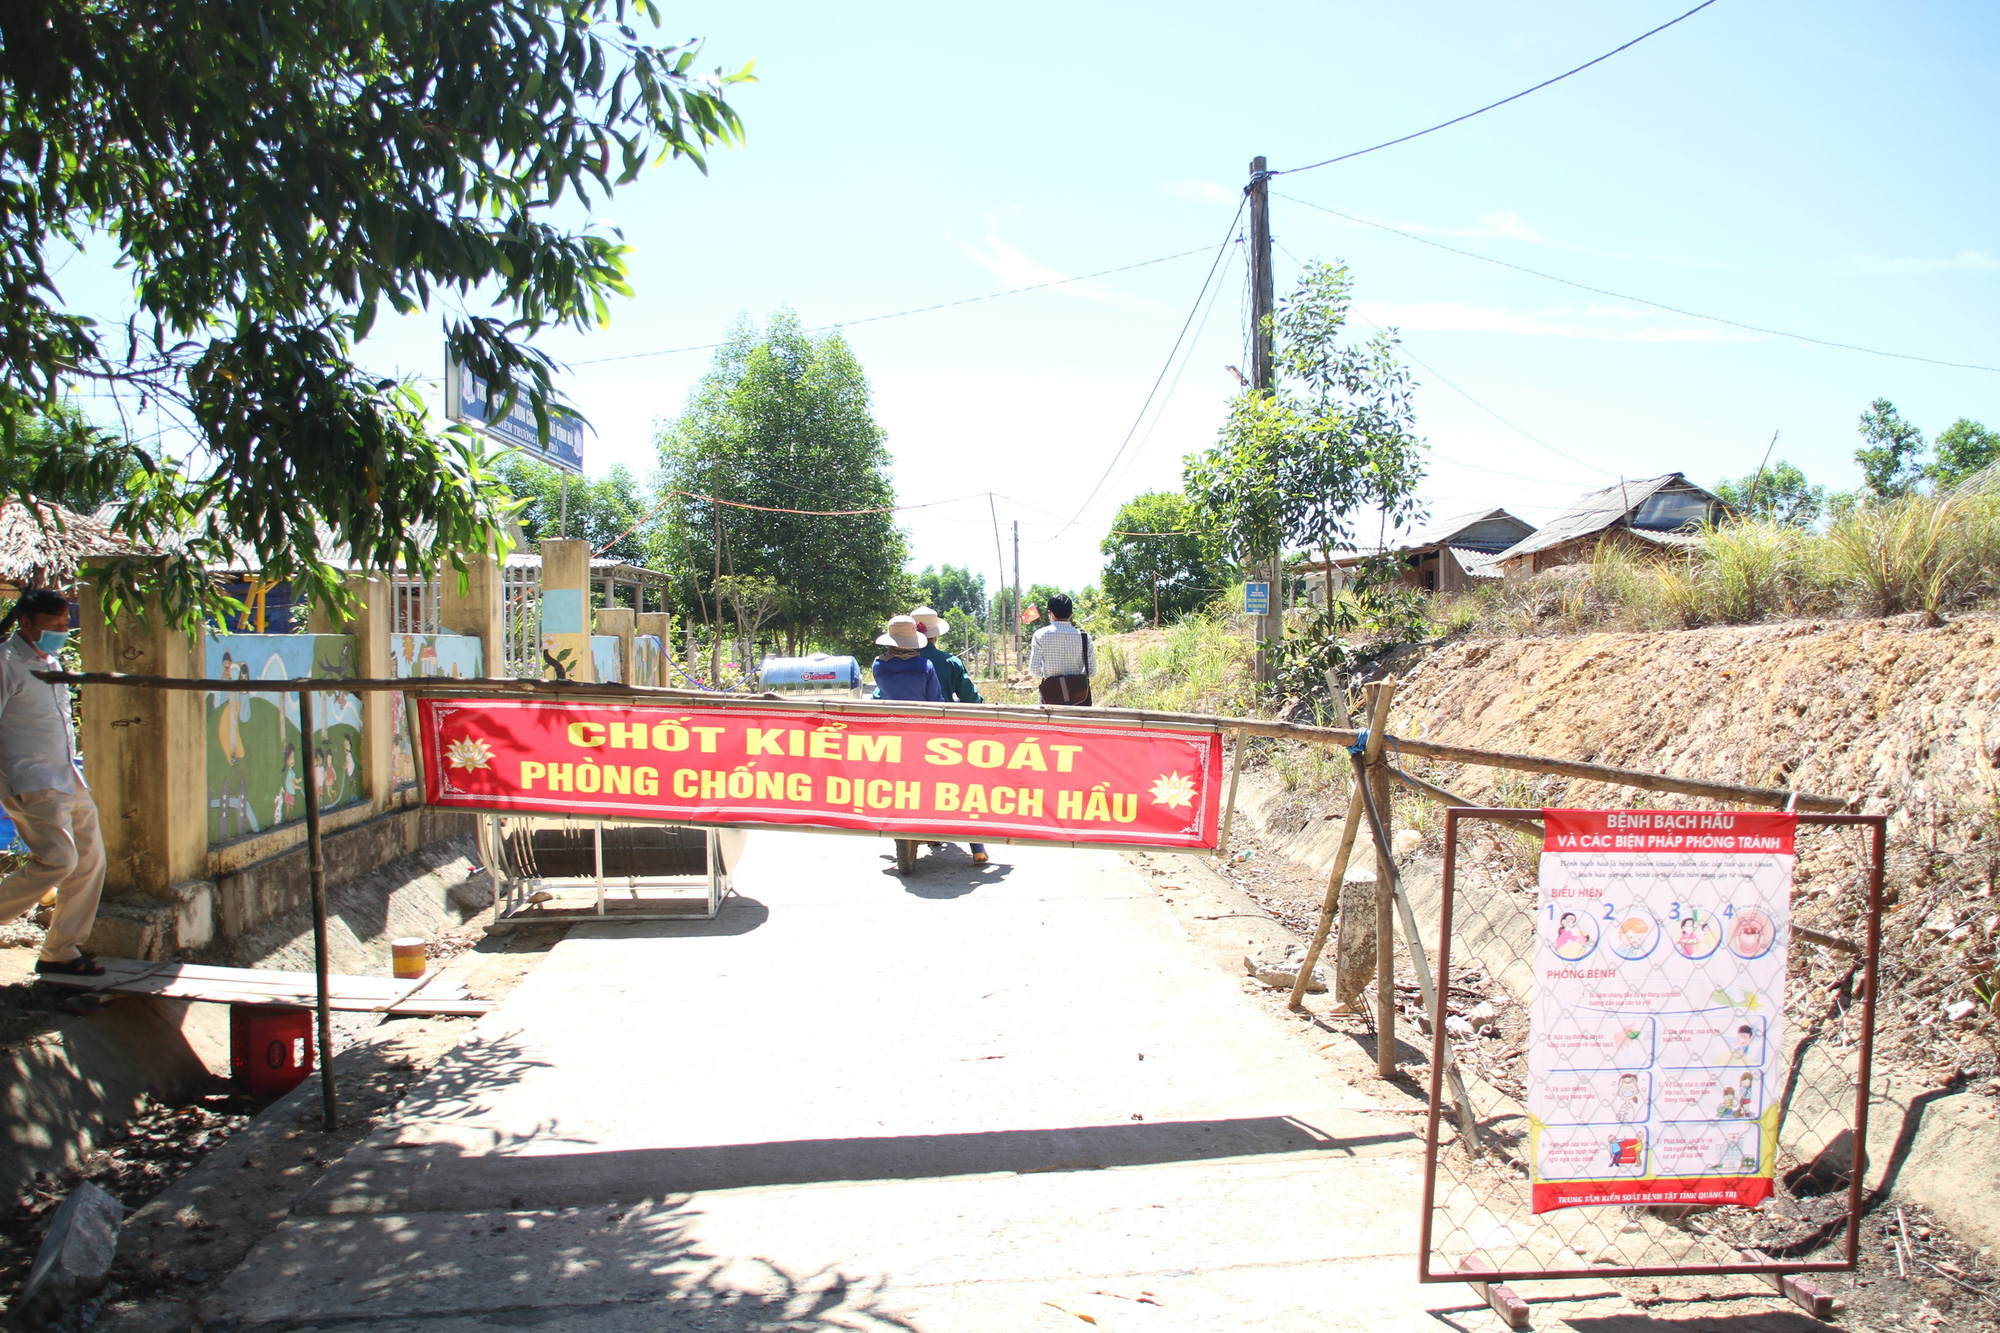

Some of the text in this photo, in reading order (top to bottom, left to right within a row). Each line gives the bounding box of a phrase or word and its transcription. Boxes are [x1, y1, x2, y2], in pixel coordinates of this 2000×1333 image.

[568, 717, 1082, 773] CHỐT KIỂM SOÁT
[520, 757, 1138, 823] PHÒNG CHỐNG DỊCH BẠCH HẦU
[1607, 812, 1651, 832] BỆNH
[1654, 814, 1698, 832] BẠCH
[1557, 832, 1780, 850] VÀ CÁC BIỆN PHÁP PHÒNG TRÁNH
[1551, 886, 1603, 900] BIỂU HIỆN
[1547, 904, 1553, 920] 1
[1602, 903, 1615, 920] 2
[1669, 902, 1680, 920] 3
[1723, 904, 1734, 920] 4
[1546, 967, 1616, 981] PHÒNG BỆNH
[1558, 1196, 1583, 1204] TRUNG
[1622, 1192, 1641, 1201] SOÁT
[1642, 1192, 1662, 1202] BỆNH
[1698, 1190, 1723, 1200] QUẢNG
[1724, 1191, 1737, 1200] TRỊ
